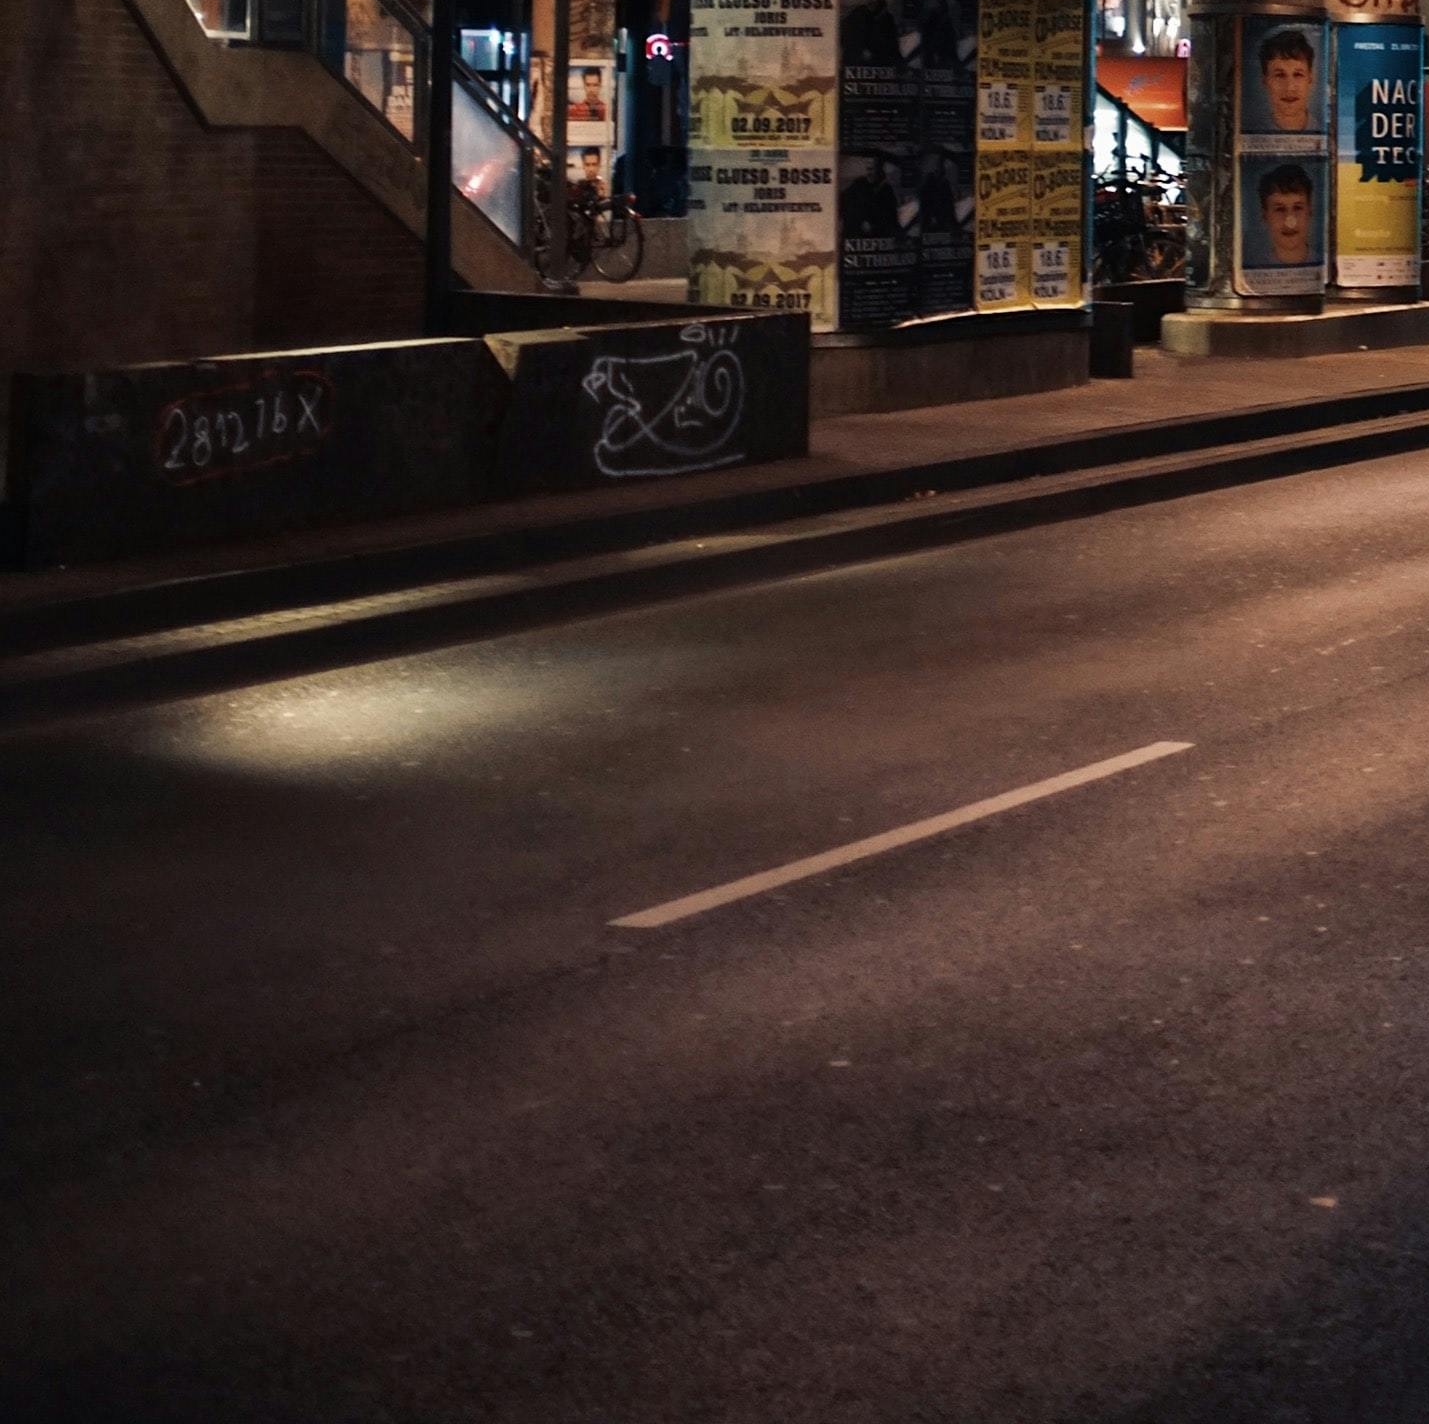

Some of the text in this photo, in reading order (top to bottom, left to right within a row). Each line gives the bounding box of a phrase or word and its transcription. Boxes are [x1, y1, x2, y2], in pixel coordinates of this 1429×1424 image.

[754, 12, 788, 24] JORIS
[1371, 78, 1417, 105] NAC
[731, 117, 812, 134] 02.09.2017
[1371, 113, 1416, 138] DER
[1371, 146, 1417, 165] TEC
[716, 167, 770, 185] CLUESO
[779, 167, 832, 185] BOSSE
[754, 187, 787, 200] JORIS
